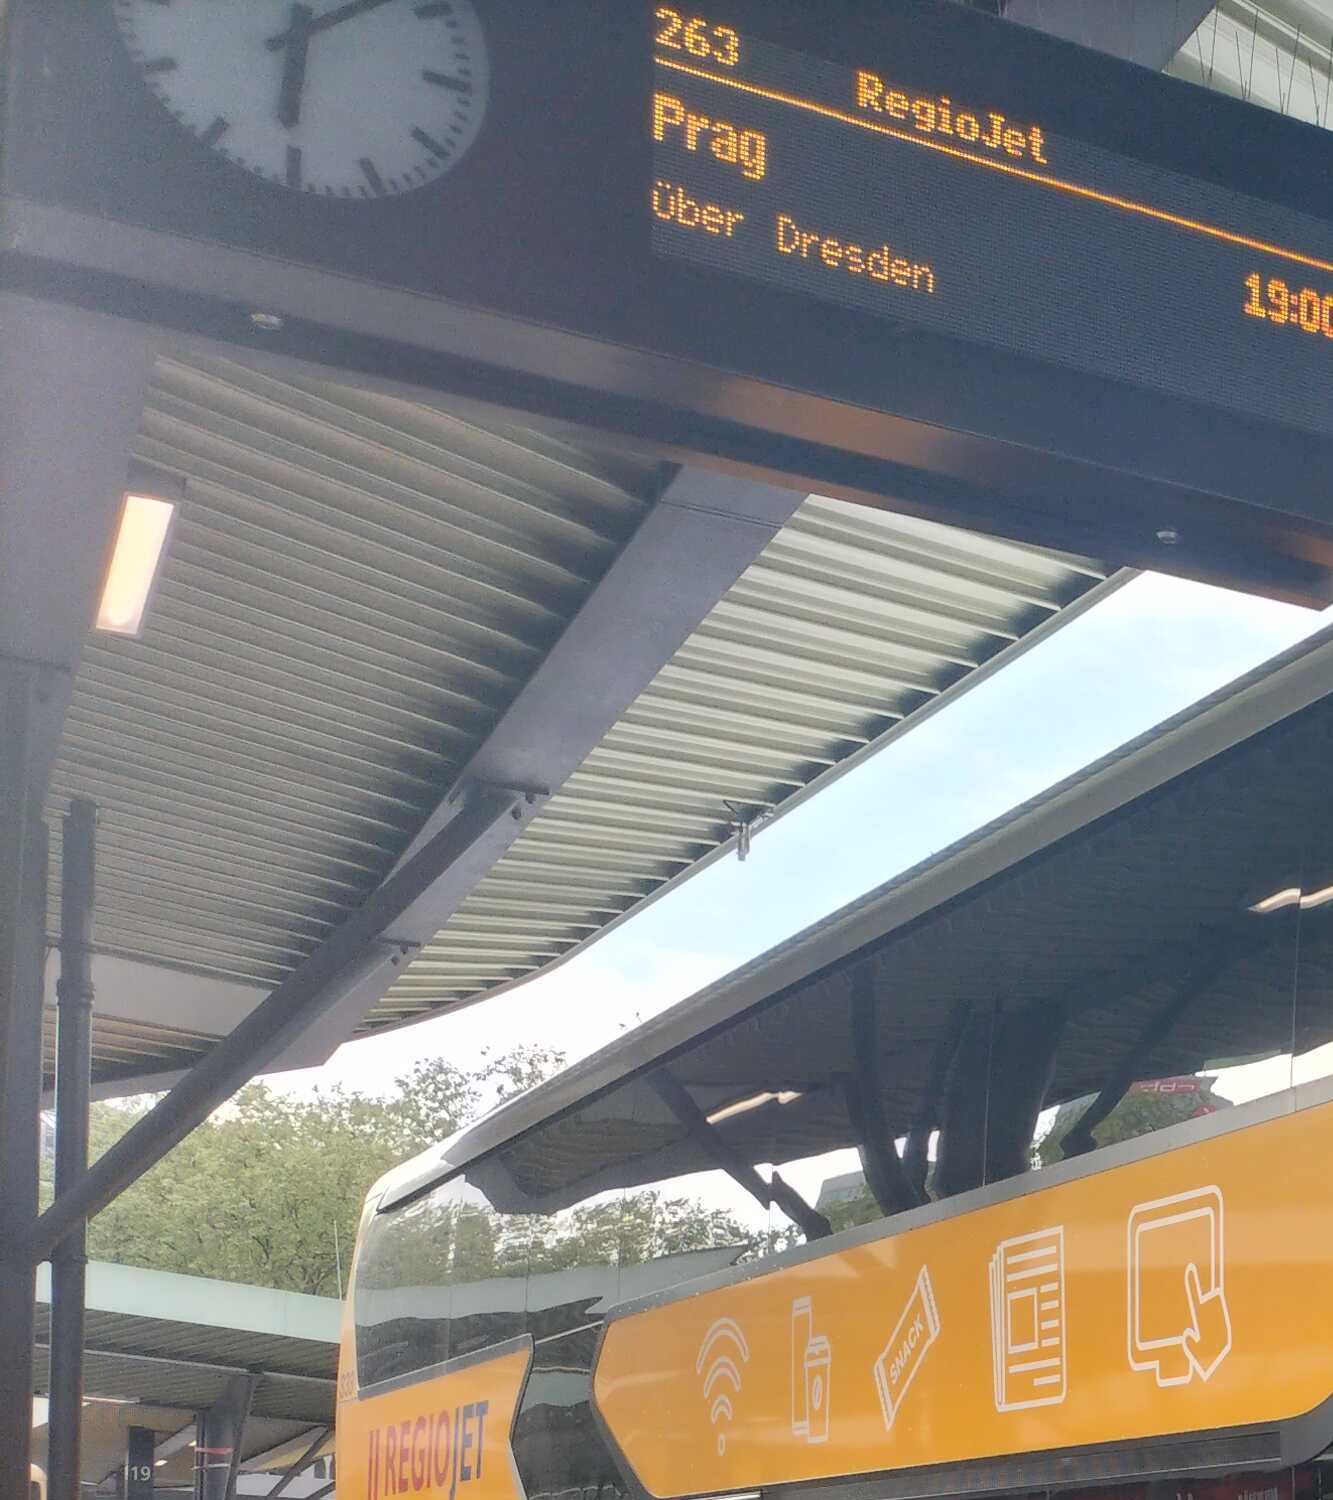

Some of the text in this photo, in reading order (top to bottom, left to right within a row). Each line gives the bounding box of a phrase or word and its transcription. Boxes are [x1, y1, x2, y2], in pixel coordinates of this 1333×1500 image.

[654, 6, 741, 67] 263
[651, 92, 767, 181] Prag
[856, 70, 1049, 166] RegioJet
[651, 179, 935, 294] über Dresden
[889, 1312, 924, 1385] SNACK
[131, 1465, 151, 1481] 19
